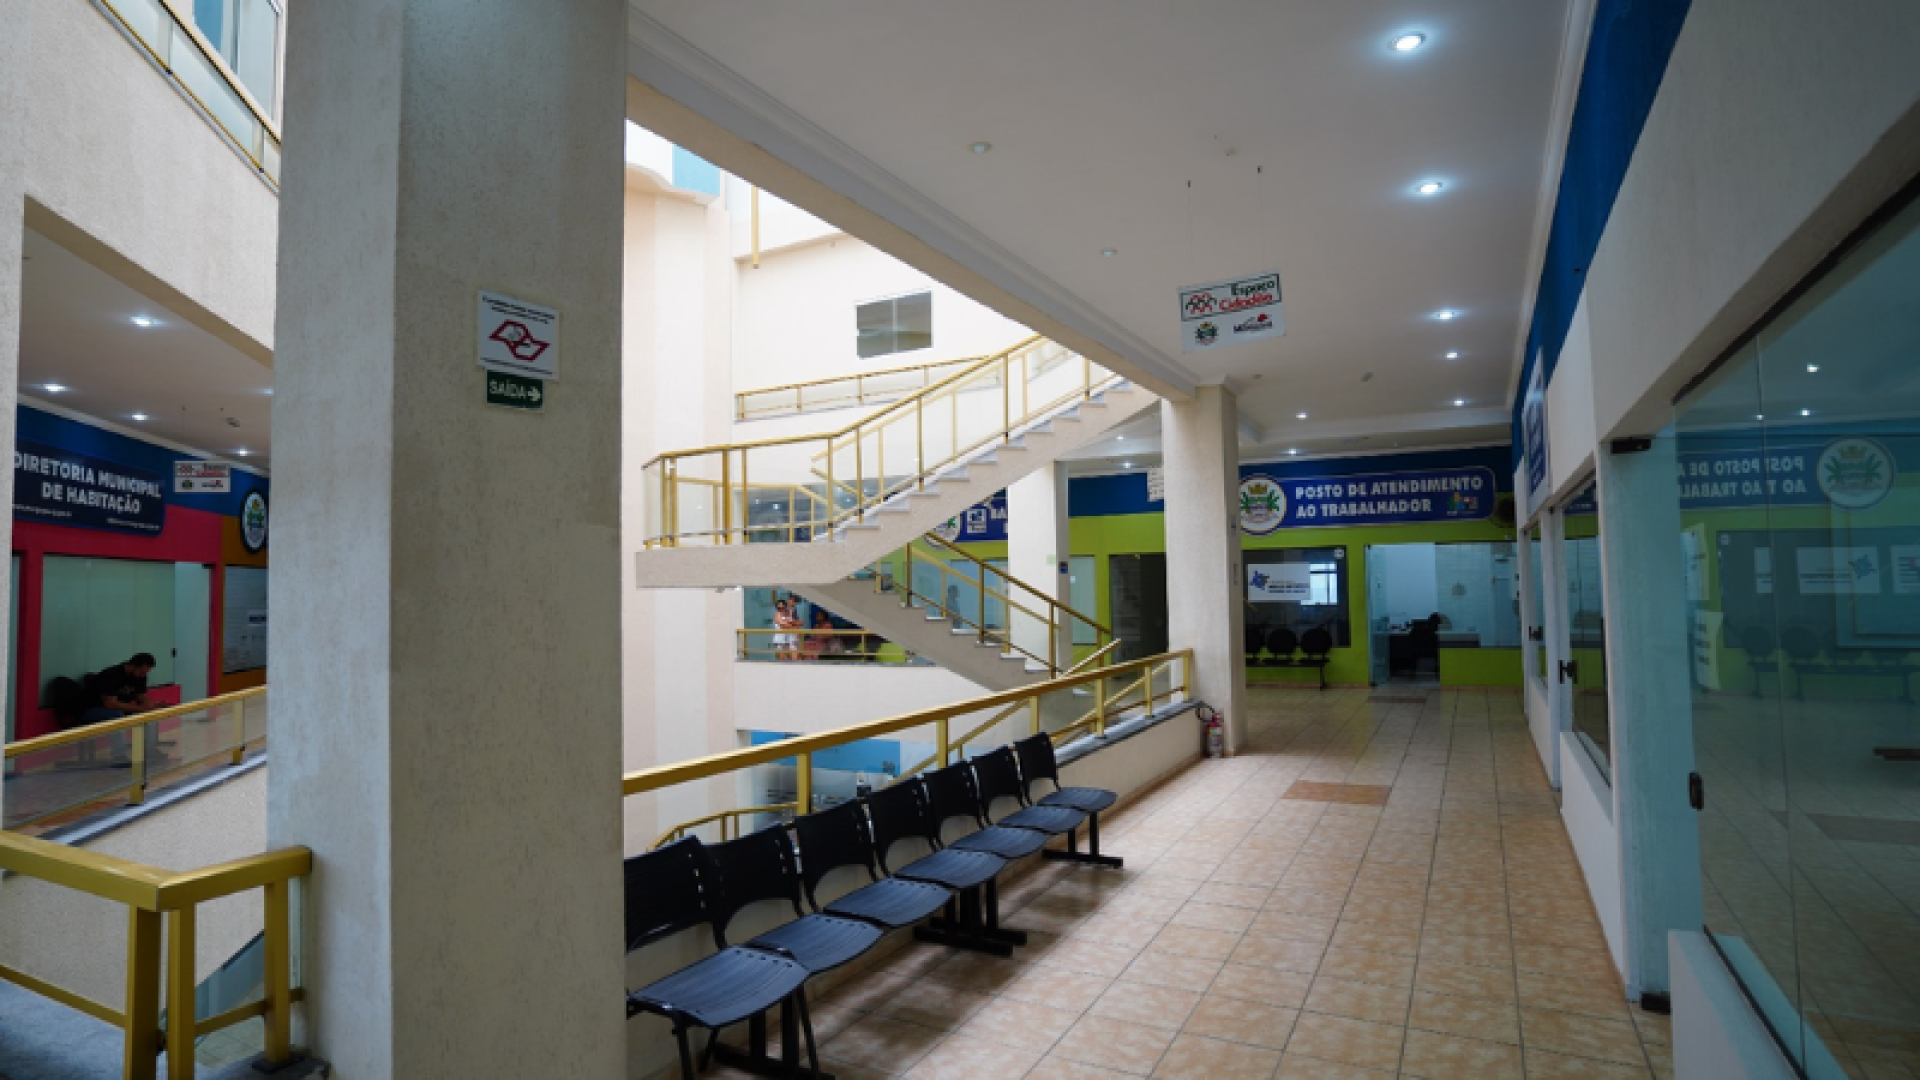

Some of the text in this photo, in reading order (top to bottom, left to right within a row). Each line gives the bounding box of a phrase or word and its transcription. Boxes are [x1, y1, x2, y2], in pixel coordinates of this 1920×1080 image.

[1231, 281, 1275, 297] Espaço
[1219, 293, 1273, 311] Cidadão
[489, 380, 527, 398] SAÍDA
[14, 452, 162, 498] DIRETORIA MUNICIPAL
[41, 482, 64, 500] DE
[67, 487, 141, 514] HABITAÇÃO
[1295, 476, 1483, 500] POSTO DE ATENDIMENTO
[1296, 498, 1433, 518] AO TRABALHADOR
